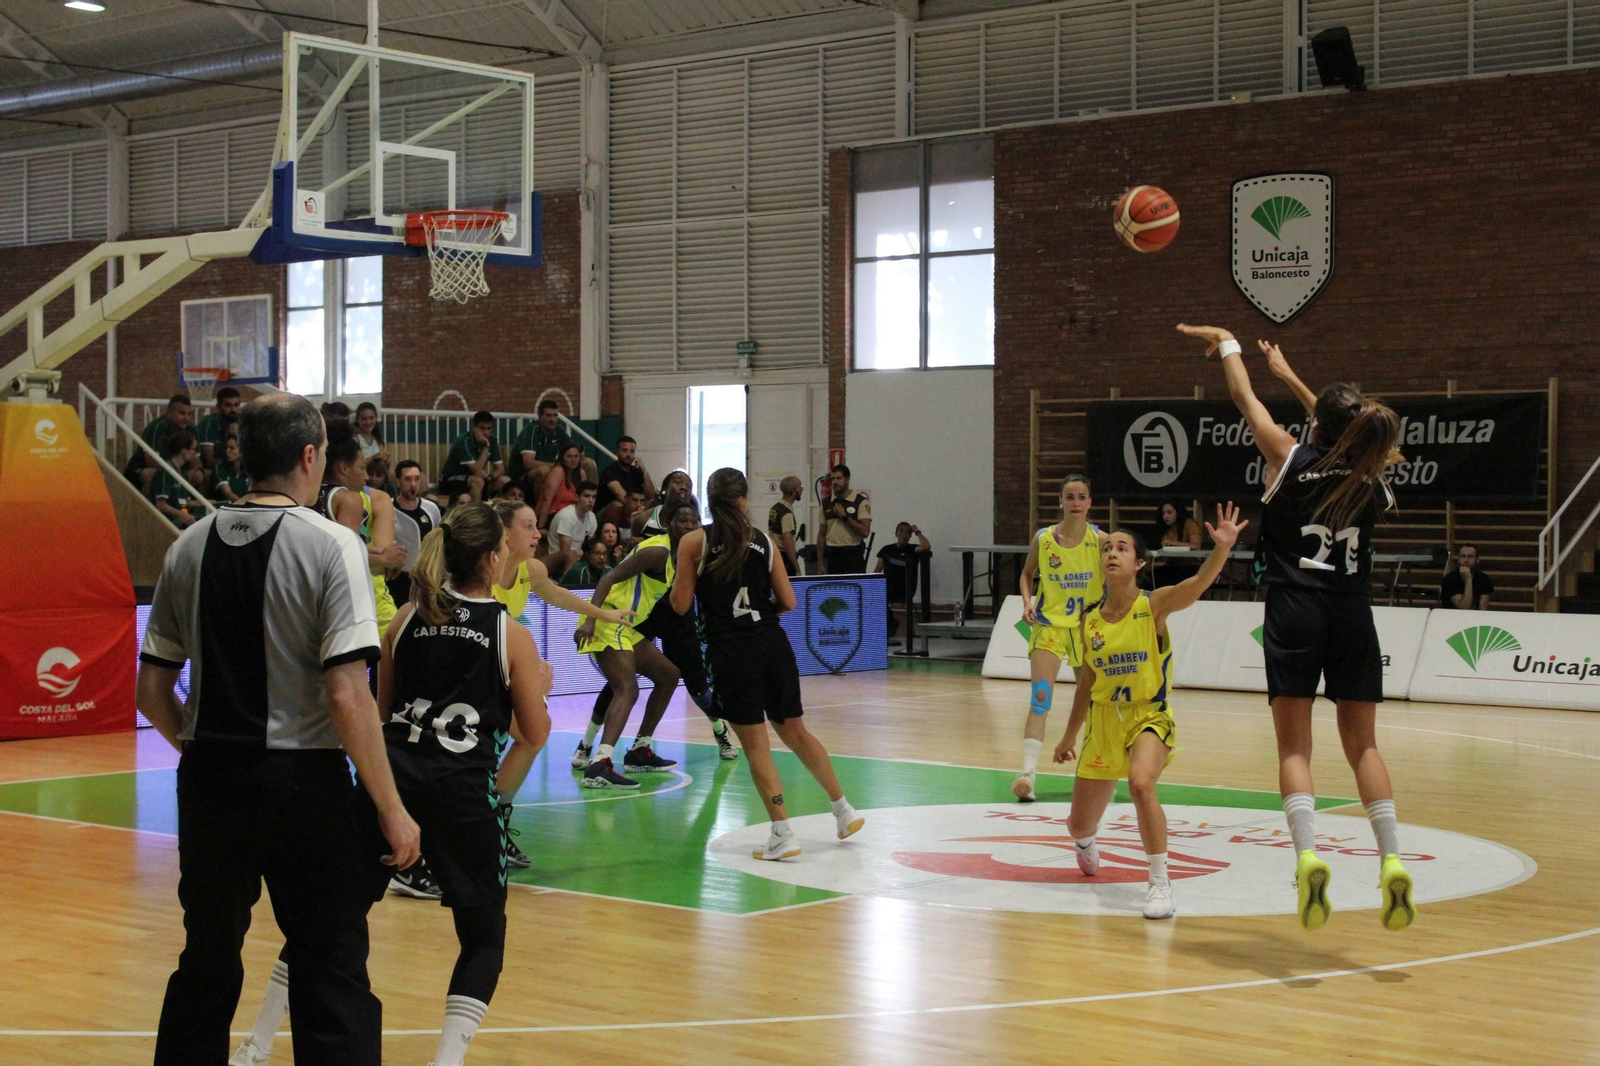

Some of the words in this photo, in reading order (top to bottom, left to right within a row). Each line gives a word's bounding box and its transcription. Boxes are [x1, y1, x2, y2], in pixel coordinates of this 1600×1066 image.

[1252, 245, 1309, 264] Unicaja
[1252, 269, 1310, 280] Baloncesto
[1196, 416, 1313, 446] Fedeci
[1398, 415, 1496, 446] aluza
[1299, 524, 1360, 575] 21
[732, 587, 761, 622] 4
[1066, 597, 1084, 616] 91
[413, 625, 438, 638] CAB
[1513, 655, 1600, 681] Unicaja
[19, 705, 53, 715] COSTA
[54, 703, 75, 714] DEL
